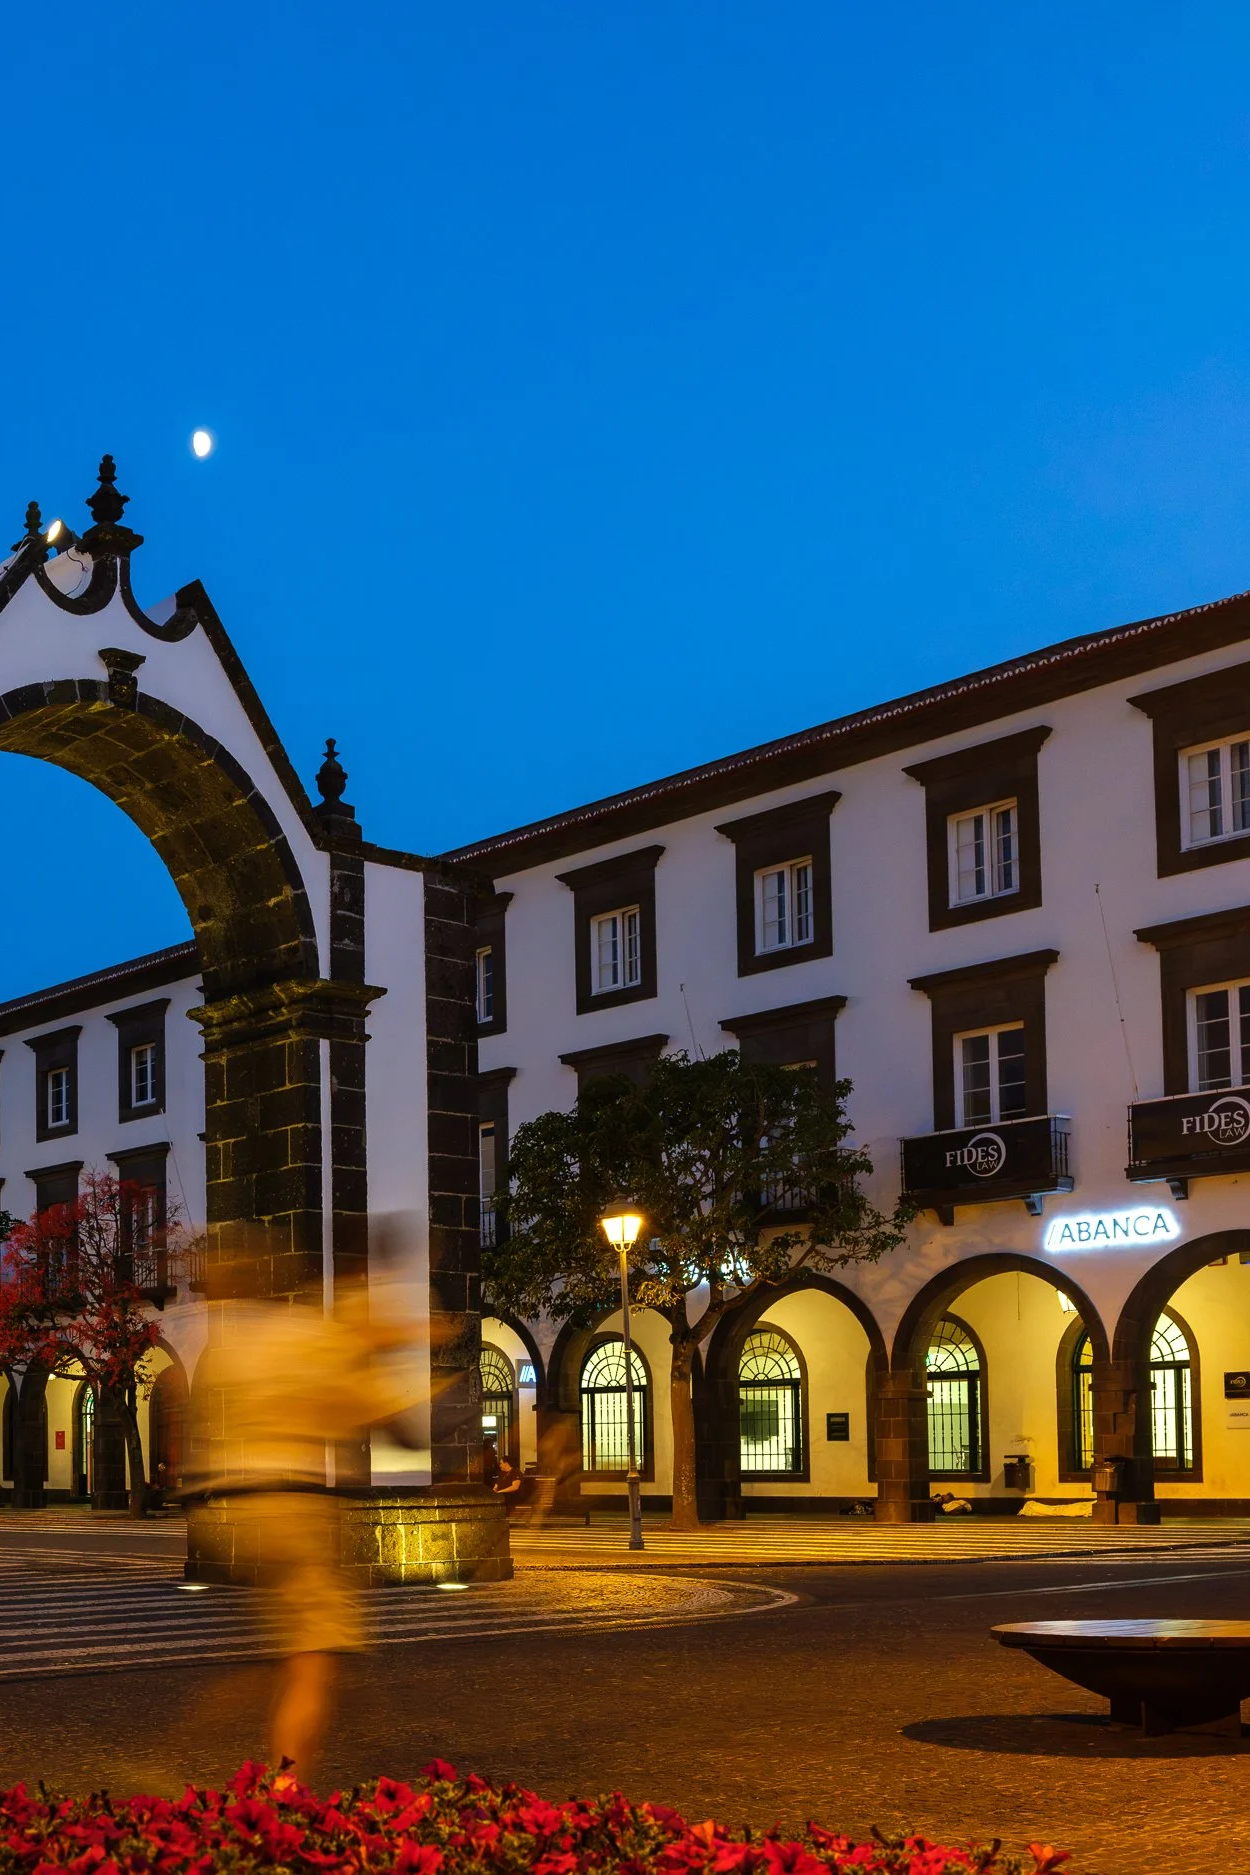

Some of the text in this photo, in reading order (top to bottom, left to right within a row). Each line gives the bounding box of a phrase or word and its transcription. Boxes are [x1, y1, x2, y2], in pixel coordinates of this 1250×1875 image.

[1182, 1110, 1245, 1135] FIDES
[1219, 1127, 1245, 1139] LAW
[945, 1145, 999, 1167] FIDES
[976, 1161, 998, 1171] LAW
